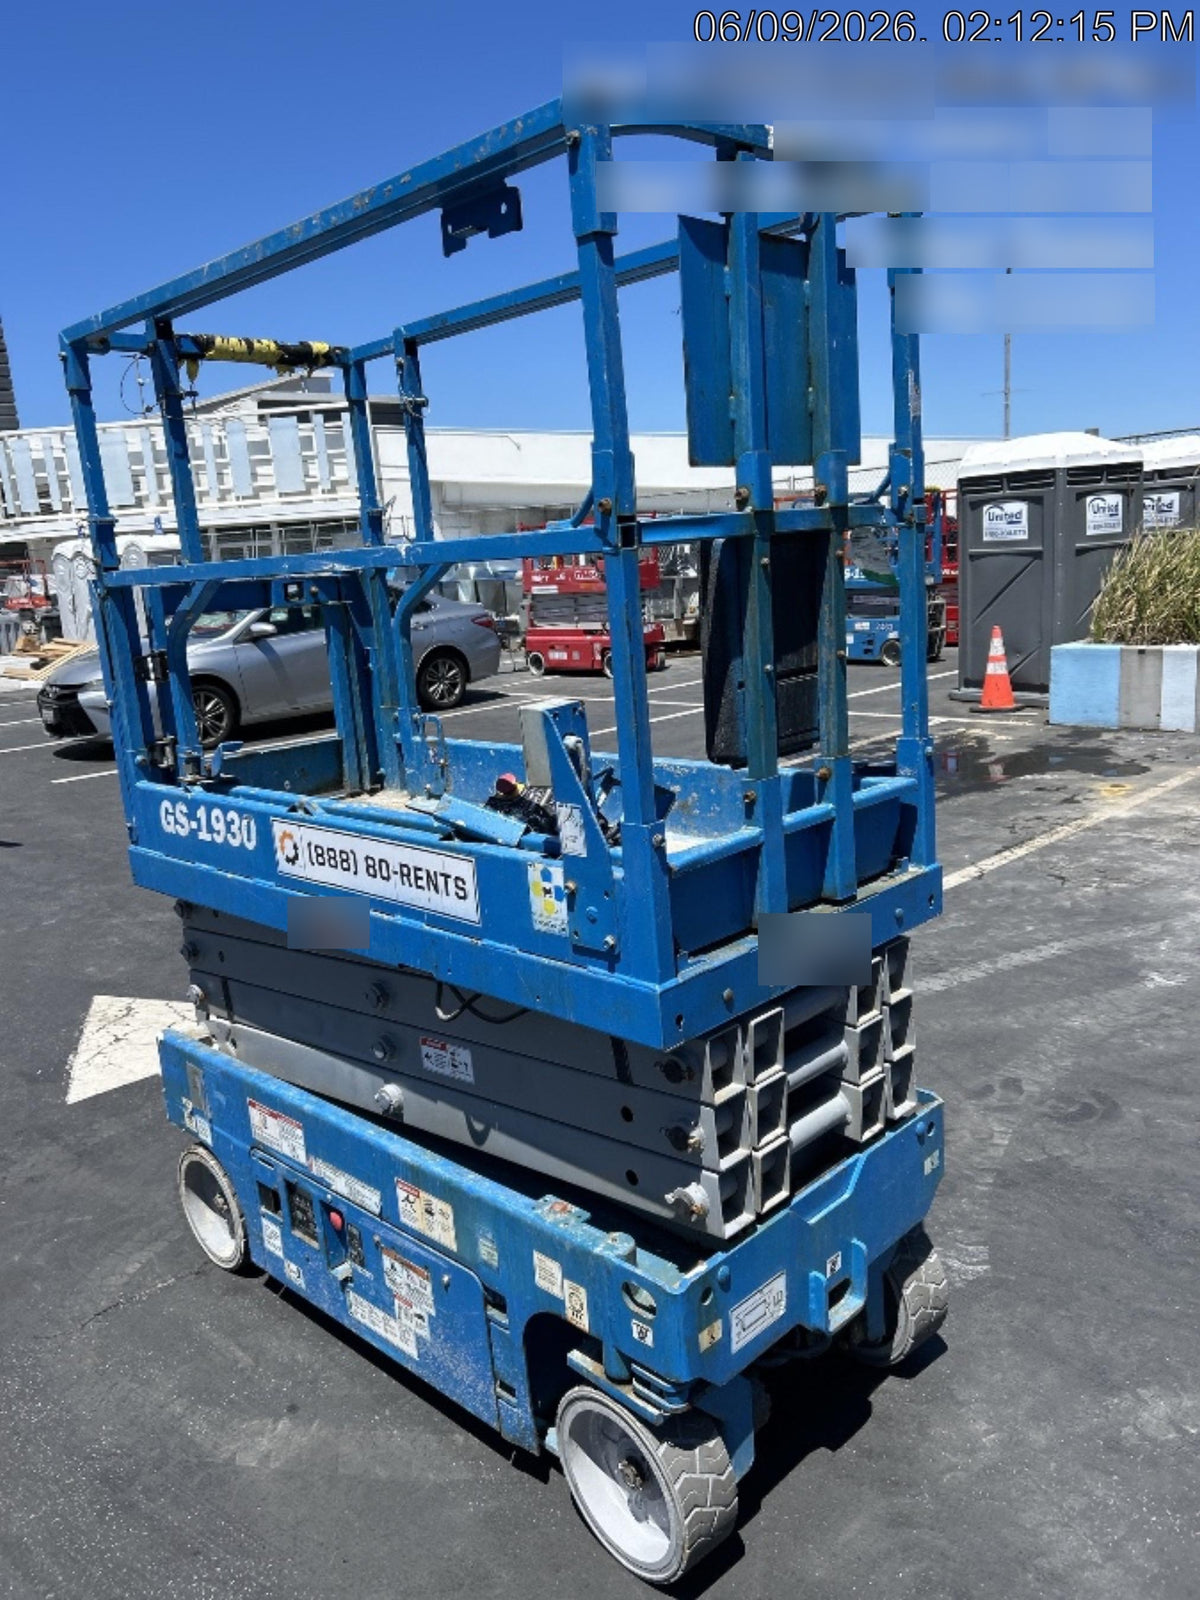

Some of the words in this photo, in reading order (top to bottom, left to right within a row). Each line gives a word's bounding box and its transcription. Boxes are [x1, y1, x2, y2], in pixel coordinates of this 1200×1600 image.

[988, 508, 1023, 522] United
[160, 799, 257, 850] GS-1930
[307, 844, 358, 876] (888)
[364, 857, 468, 902] 80-RENTS
